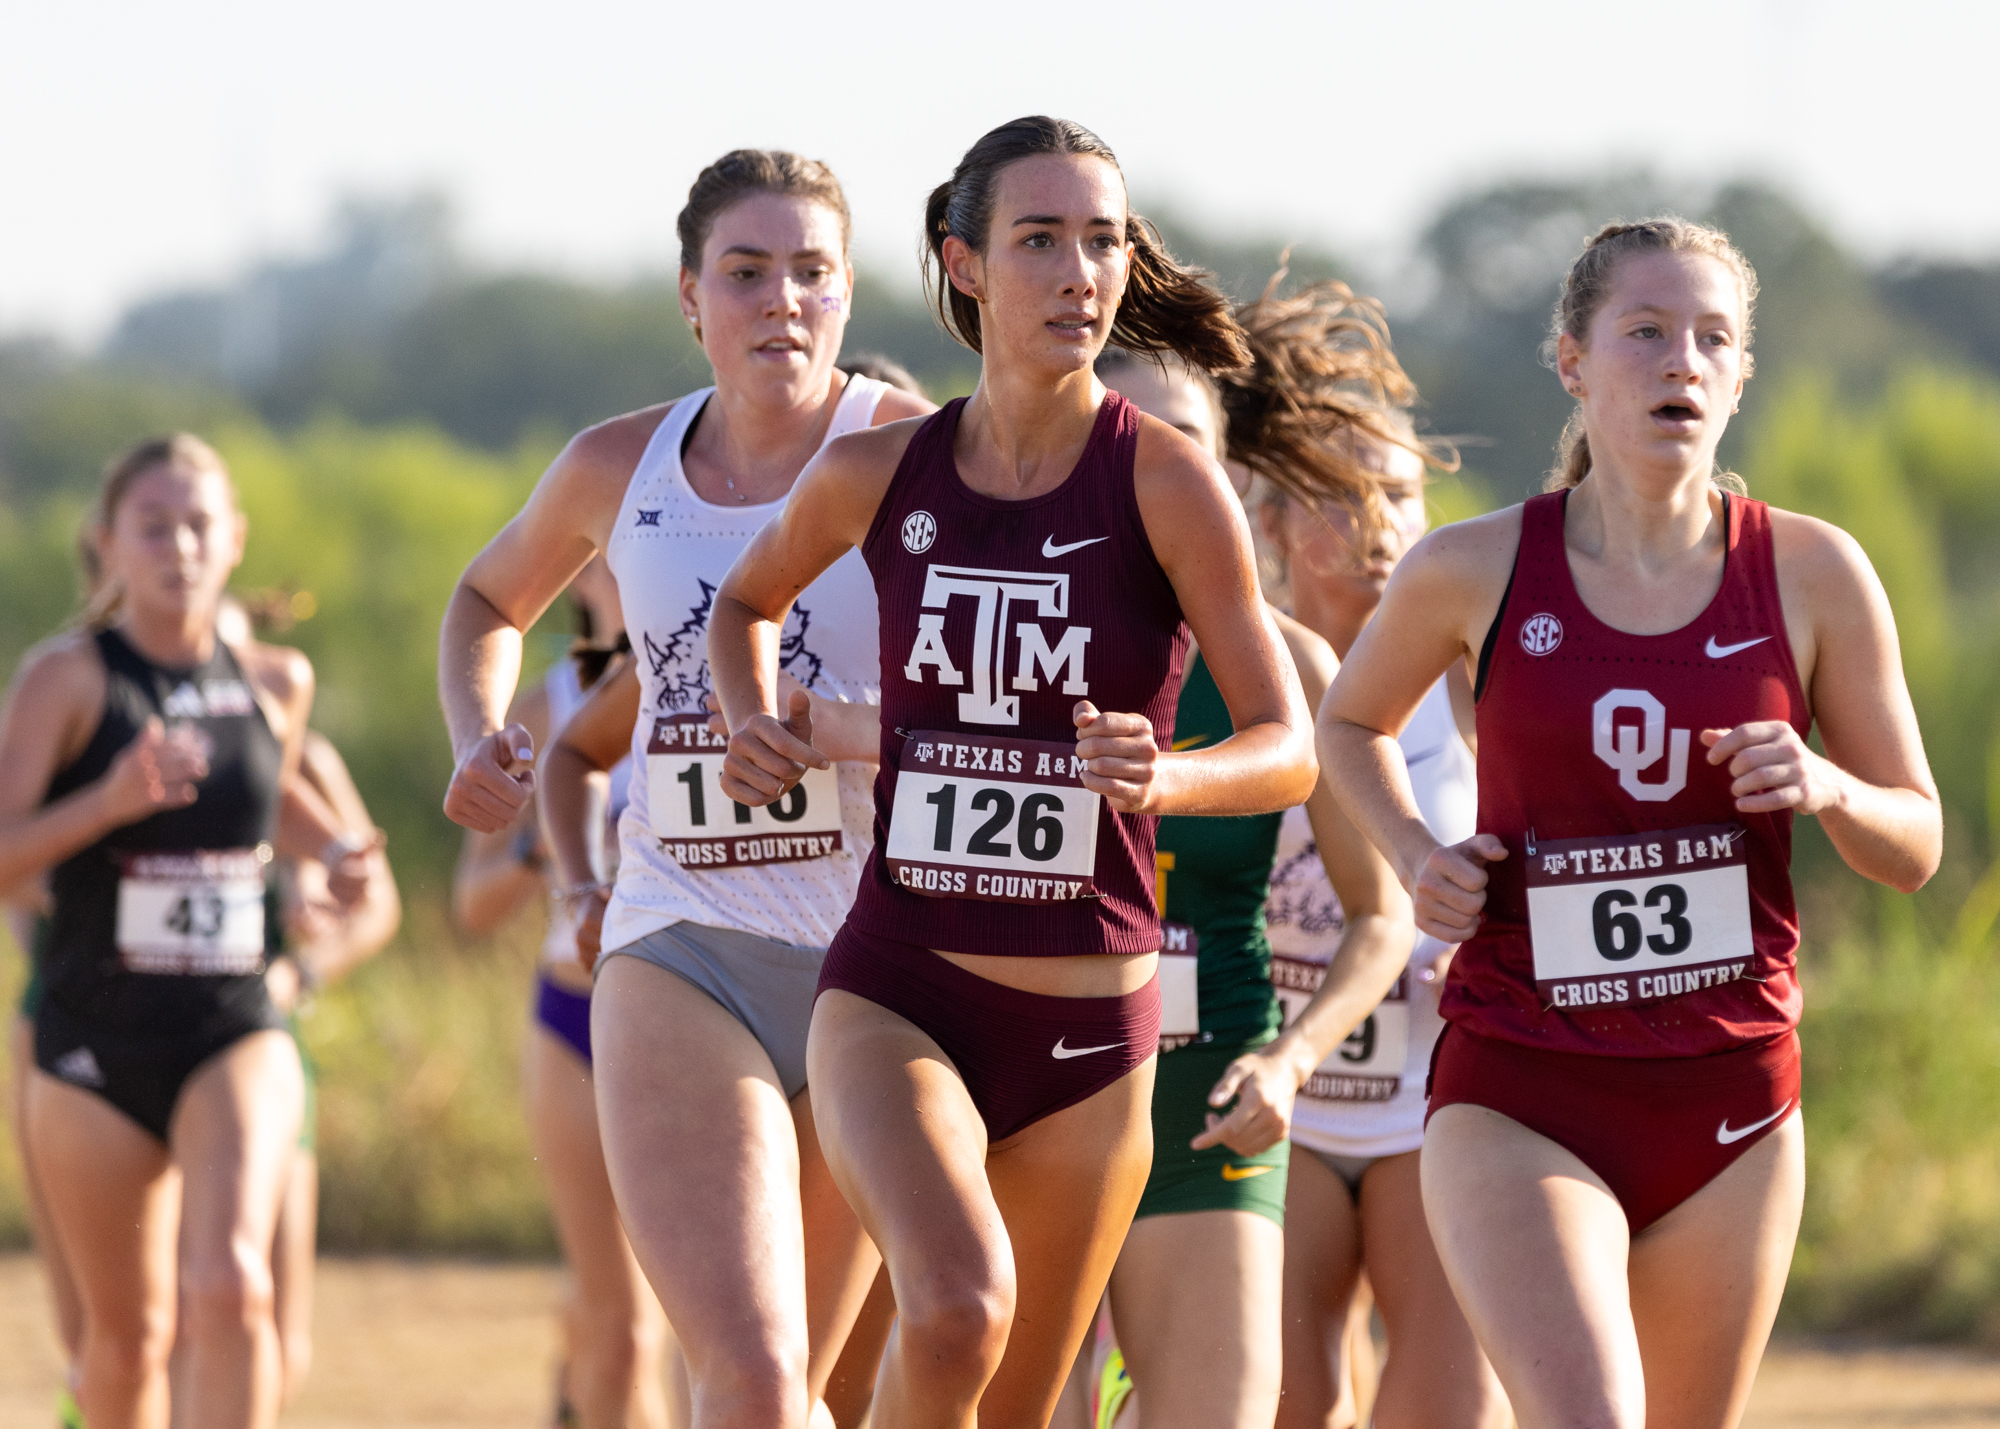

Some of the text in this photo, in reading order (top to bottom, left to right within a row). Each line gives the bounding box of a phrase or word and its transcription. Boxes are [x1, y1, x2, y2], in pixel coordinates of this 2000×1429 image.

[904, 514, 934, 550] SEC
[1524, 616, 1560, 652] SEC
[680, 724, 726, 747] TEX
[1593, 688, 1691, 801] OU
[937, 743, 1023, 774] TEXAS
[1035, 753, 1089, 778] A&M
[926, 783, 1065, 862] 126
[735, 836, 835, 862] COUNTRY
[1569, 843, 1663, 875] TEXAS
[1676, 834, 1733, 865] A&M
[899, 866, 1083, 900] CROSS COUNTRY
[1592, 883, 1693, 962] 63
[1553, 963, 1746, 1007] CROSS COUNTRY
